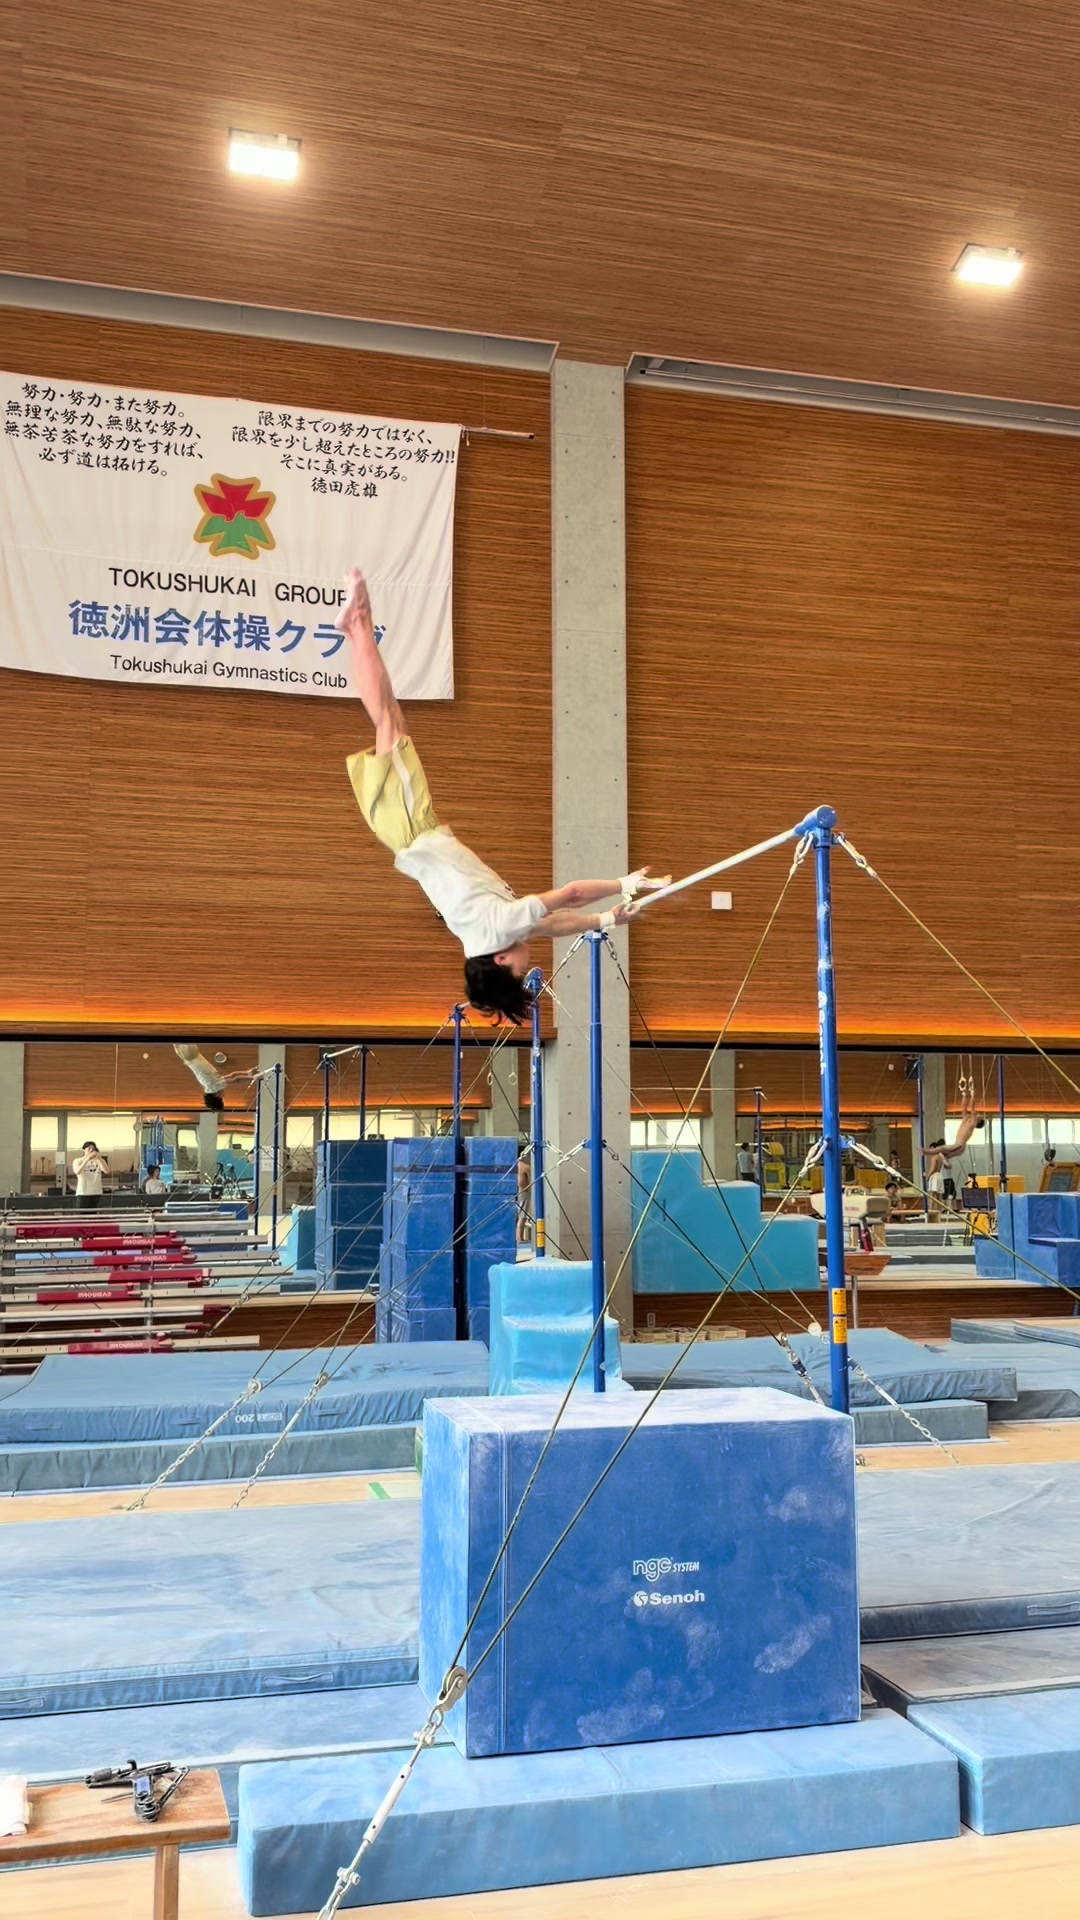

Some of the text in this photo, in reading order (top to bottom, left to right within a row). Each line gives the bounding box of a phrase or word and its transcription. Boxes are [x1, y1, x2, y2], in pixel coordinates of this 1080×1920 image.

[5, 400, 202, 440] 無理な努力、無駄な努力、
[258, 410, 433, 445] 限界までの努力ではなく、
[4, 420, 204, 460] 無茶苦茶な努力をすれば、
[38, 447, 168, 477] 必ず道は拓ける。
[280, 454, 408, 482] そこに真実がある。
[311, 477, 379, 499] 徳田虎雄
[108, 567, 257, 598] TOKUSHUKAI
[68, 599, 387, 659] 徳洲会体操クラ
[110, 654, 347, 689] Tokushukai Gymnastics Club
[672, 1561, 699, 1573] SYSTEM
[649, 1590, 705, 1605] Senoh
